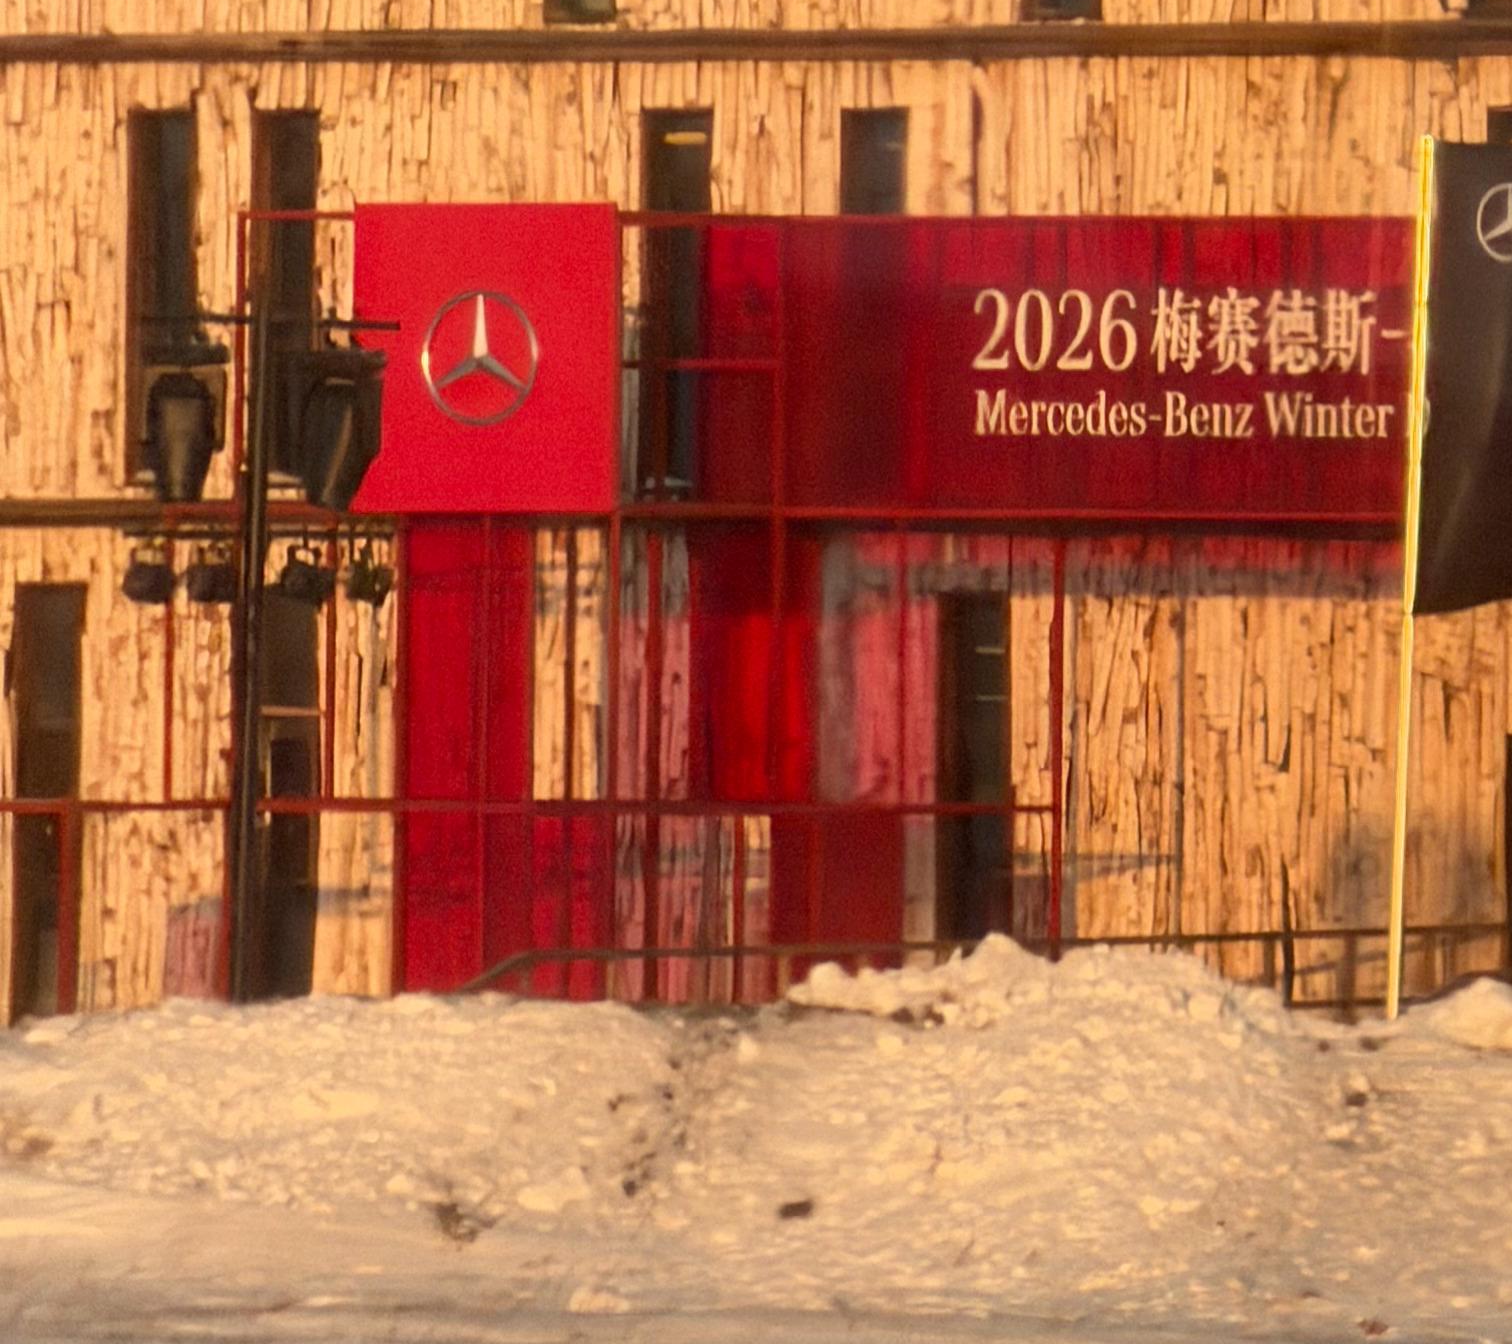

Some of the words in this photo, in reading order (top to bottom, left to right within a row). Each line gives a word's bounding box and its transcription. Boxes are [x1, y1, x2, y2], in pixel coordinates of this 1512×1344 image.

[972, 287, 1138, 372] 2026
[974, 388, 1254, 439] Mercedes-Benz
[1263, 391, 1396, 439] Winter
